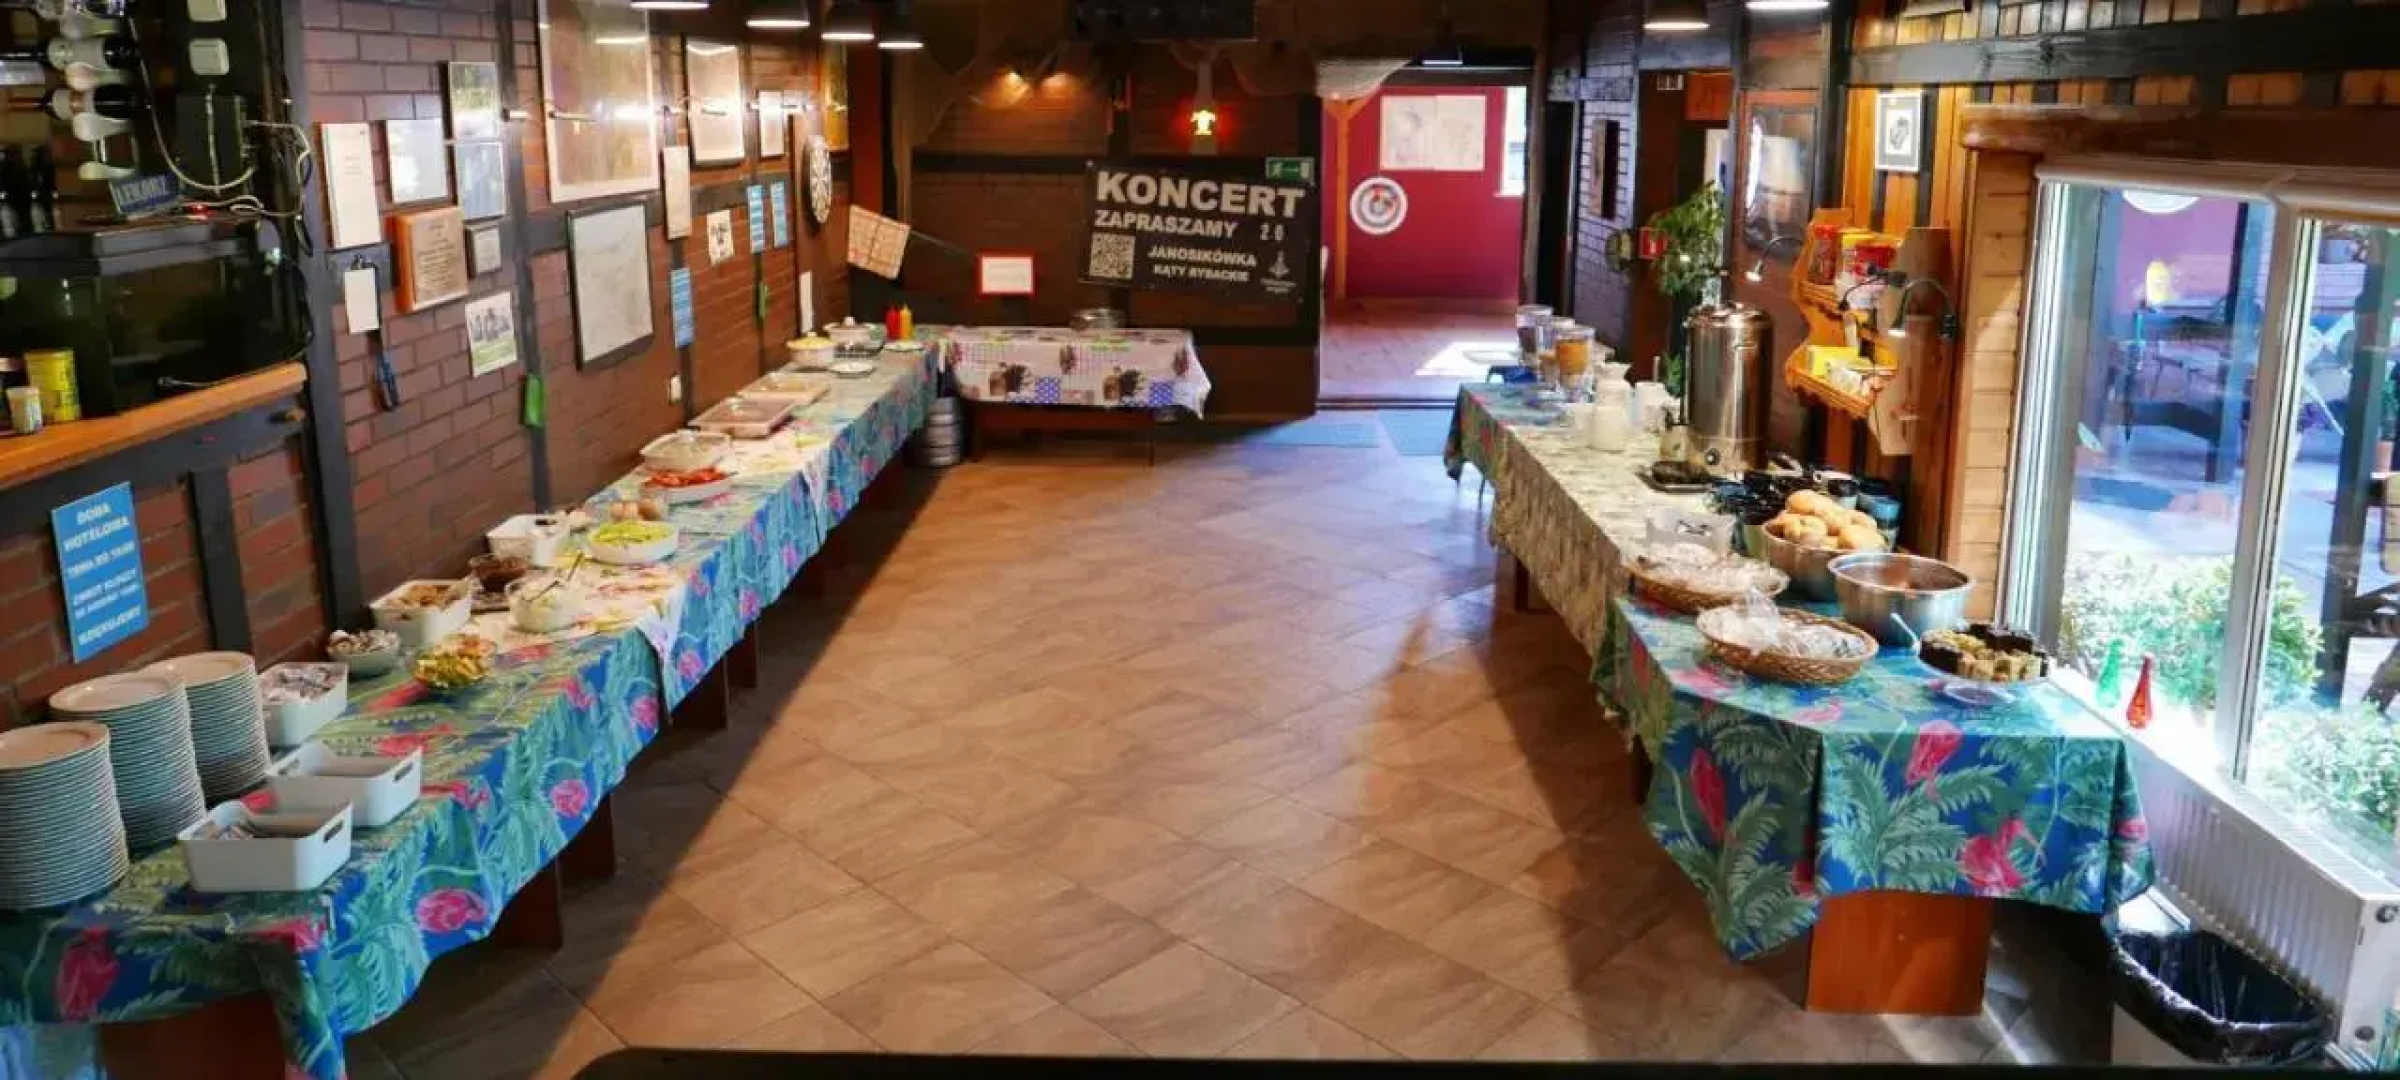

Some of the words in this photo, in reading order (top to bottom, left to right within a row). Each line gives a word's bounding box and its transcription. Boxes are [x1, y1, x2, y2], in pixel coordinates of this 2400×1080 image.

[1096, 170, 1305, 218] KONCERT
[1094, 209, 1239, 239] ZAPRASZAMY
[1148, 245, 1257, 268] JANOSIKÓWKA
